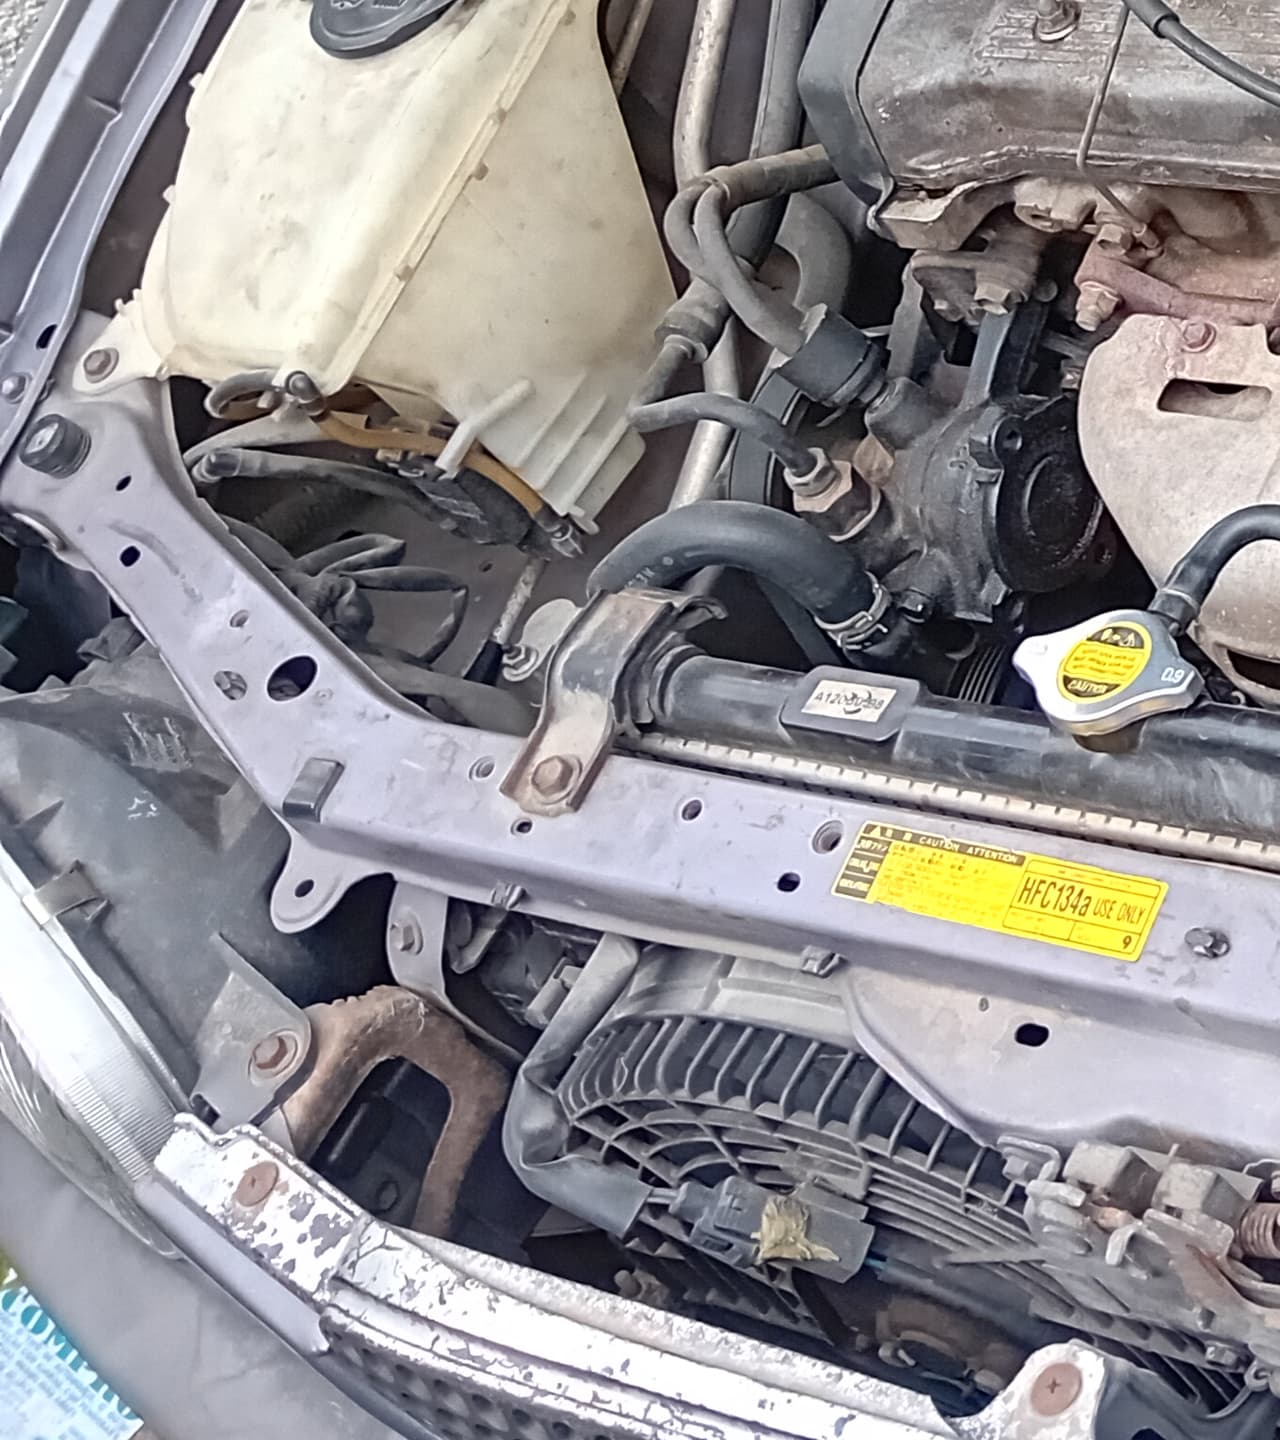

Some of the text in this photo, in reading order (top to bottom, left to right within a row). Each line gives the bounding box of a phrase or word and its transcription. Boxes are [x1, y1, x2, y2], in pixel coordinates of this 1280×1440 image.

[1161, 666, 1186, 684] 0.9
[1067, 679, 1109, 695] CAUTION
[919, 835, 1020, 864] CAUTION ATTENTION
[1017, 876, 1092, 917] HFC134a
[1092, 897, 1118, 920] USE
[1116, 902, 1145, 925] ONLY
[1122, 935, 1132, 949] 9
